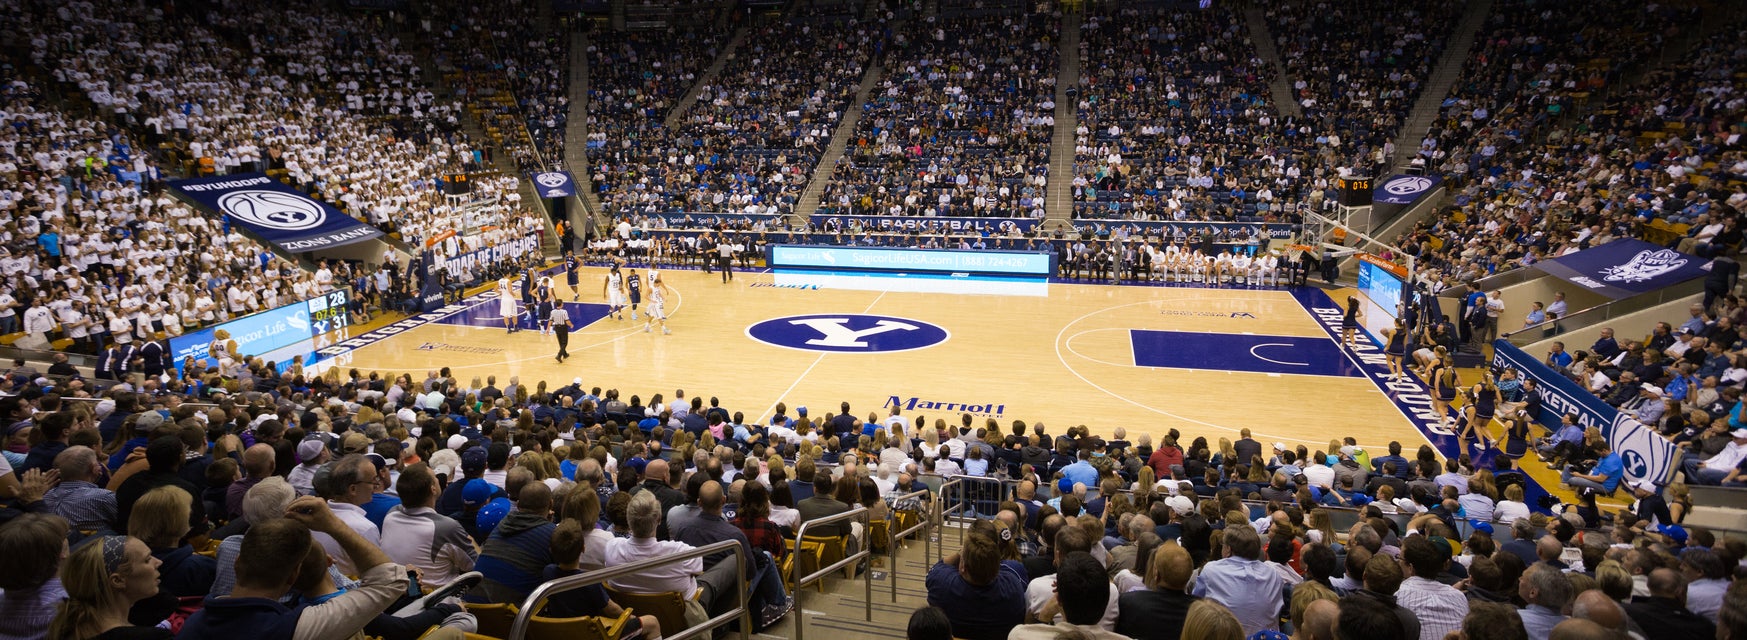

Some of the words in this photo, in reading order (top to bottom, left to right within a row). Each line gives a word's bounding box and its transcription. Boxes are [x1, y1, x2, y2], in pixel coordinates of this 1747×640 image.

[182, 176, 271, 192] #BYUHOOPS
[280, 236, 332, 250] ZIONS
[329, 226, 375, 242] BANK
[445, 253, 475, 279] ROAR
[478, 247, 491, 266] OF
[493, 234, 537, 262] COUGARS
[852, 253, 952, 266] SagicorLifeUSA.com
[962, 256, 985, 267] (888)
[987, 257, 1028, 268] 724-4267
[329, 291, 346, 307] 28
[265, 320, 287, 337] Life
[317, 304, 467, 355] BRIGHAM
[332, 313, 348, 329] 31
[788, 317, 920, 348] Y
[883, 395, 1006, 414] Marriott
[1626, 452, 1645, 477] Y
